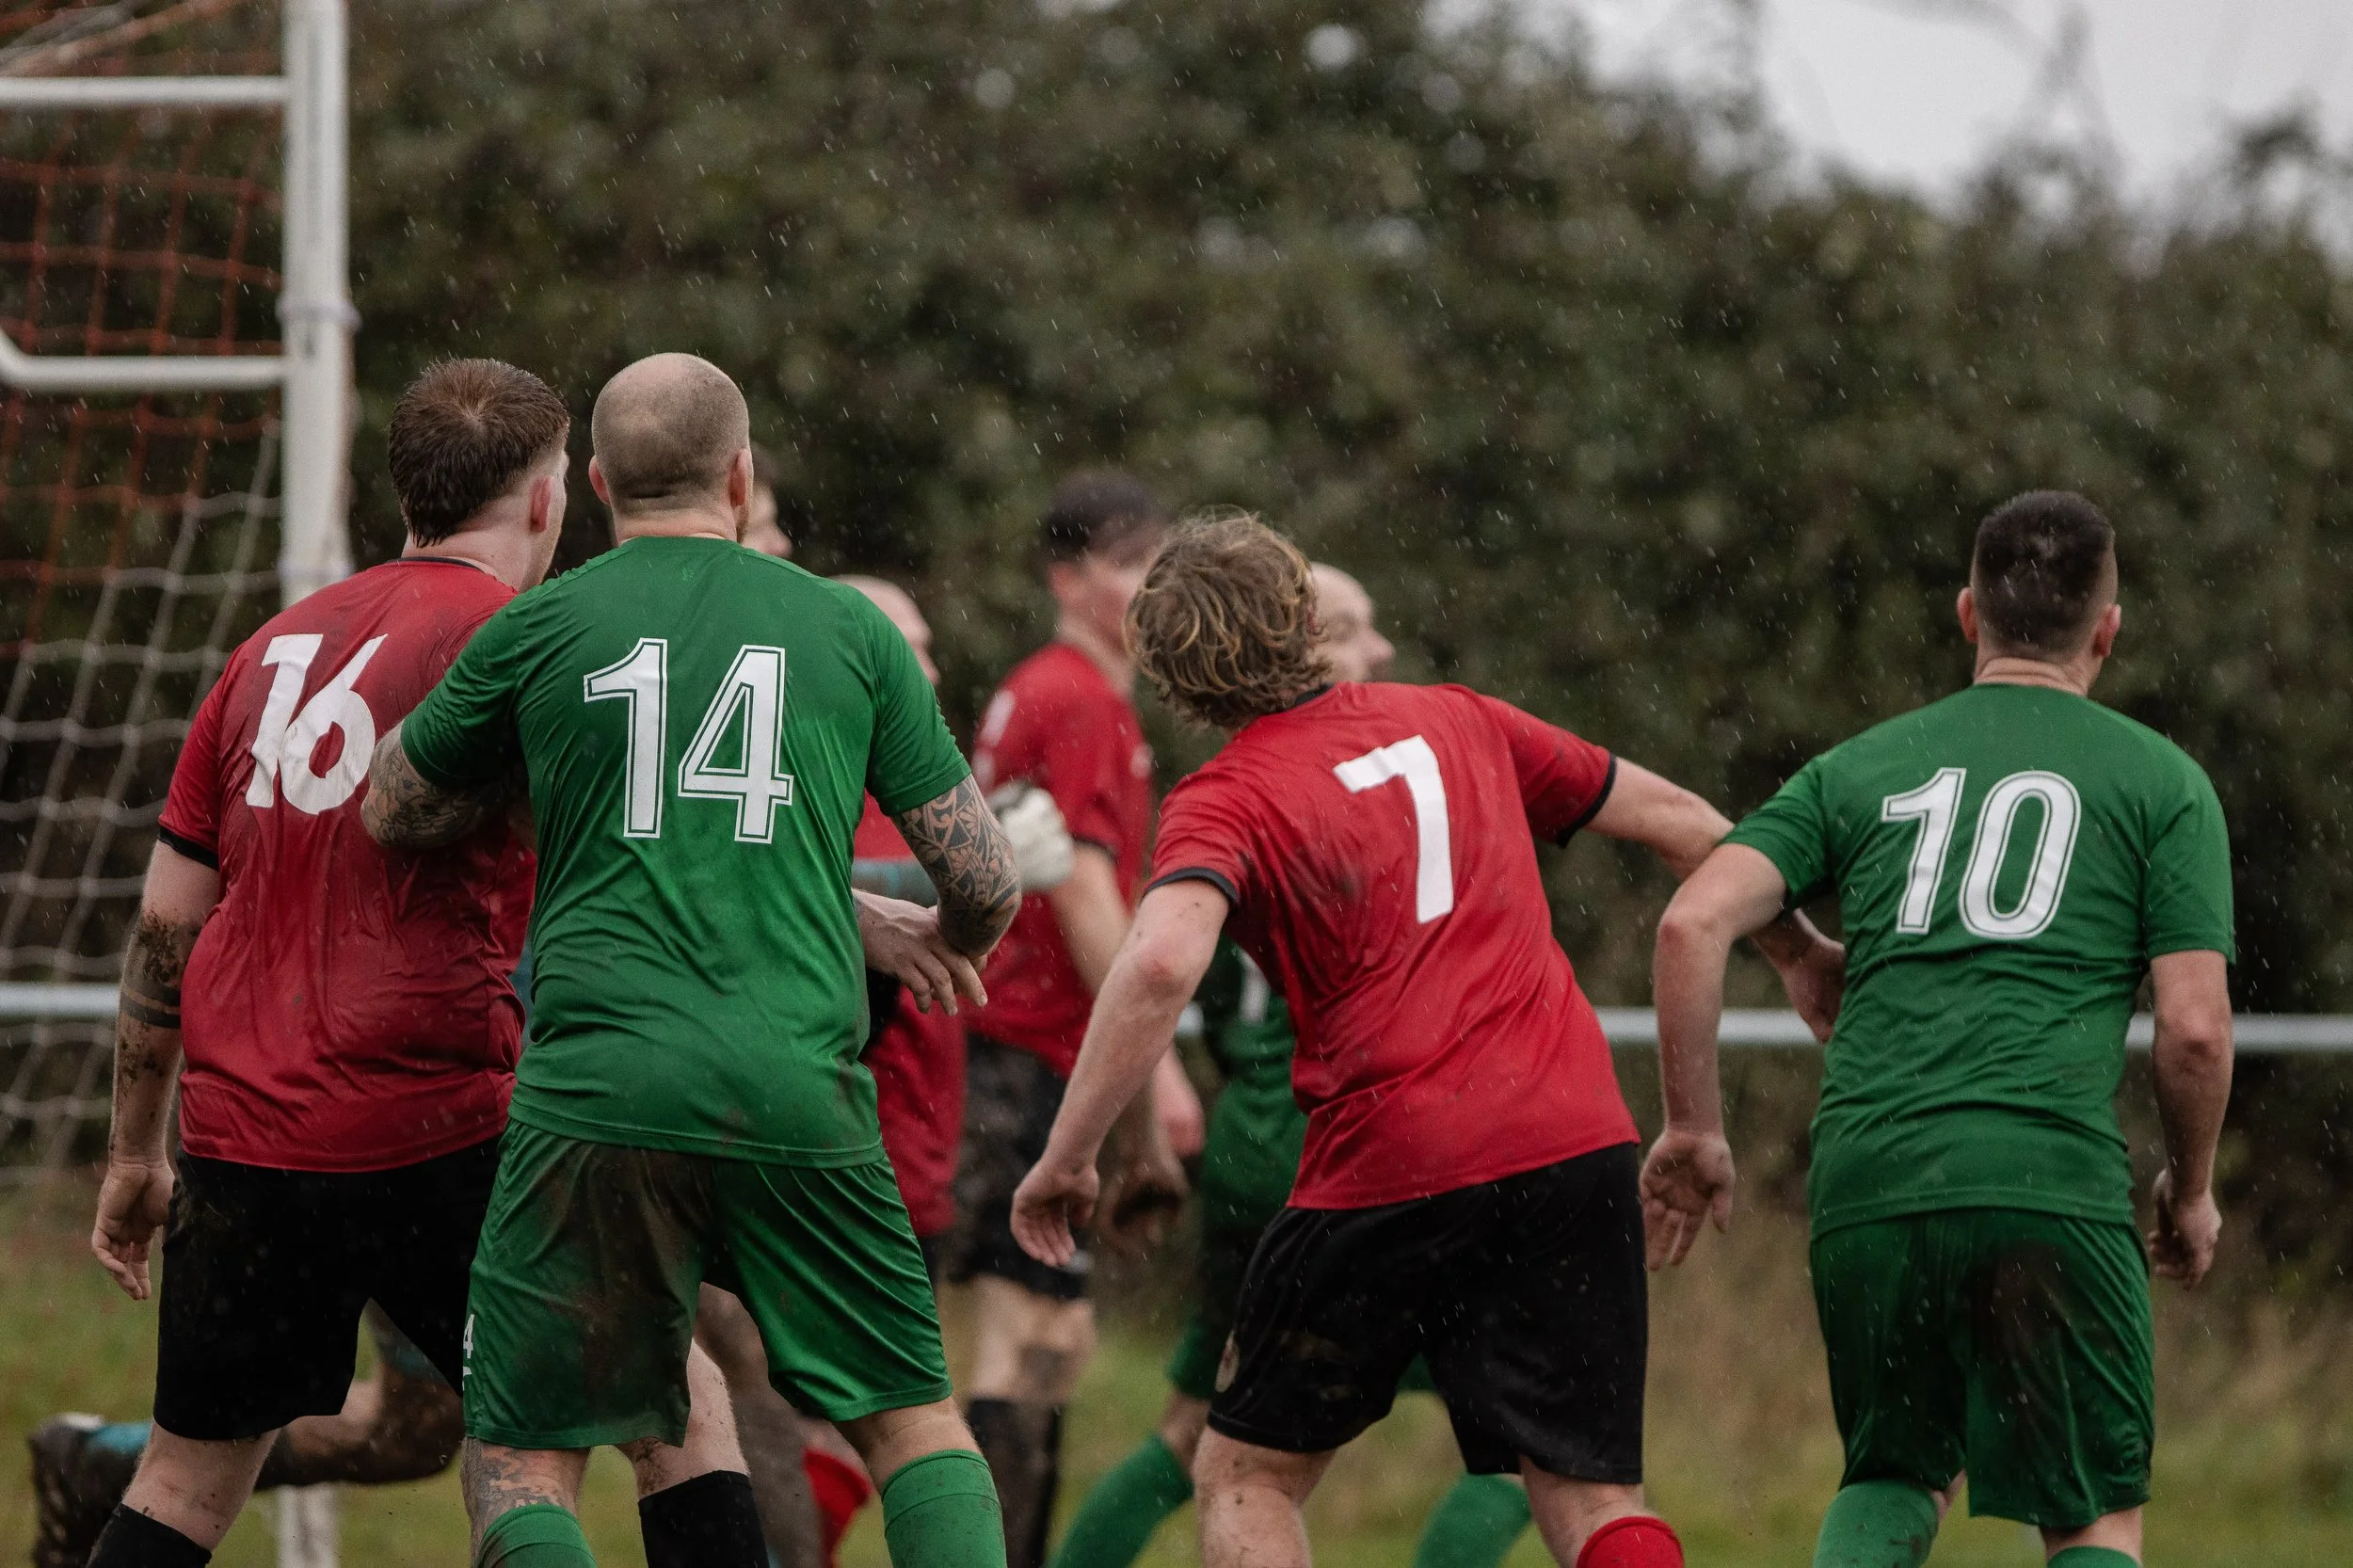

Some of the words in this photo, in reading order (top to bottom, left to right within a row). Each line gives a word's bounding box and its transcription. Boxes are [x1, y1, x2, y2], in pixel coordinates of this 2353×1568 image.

[245, 633, 388, 816] 16
[584, 637, 793, 844] 14
[1333, 734, 1454, 924] 7
[1881, 767, 2082, 940] 10
